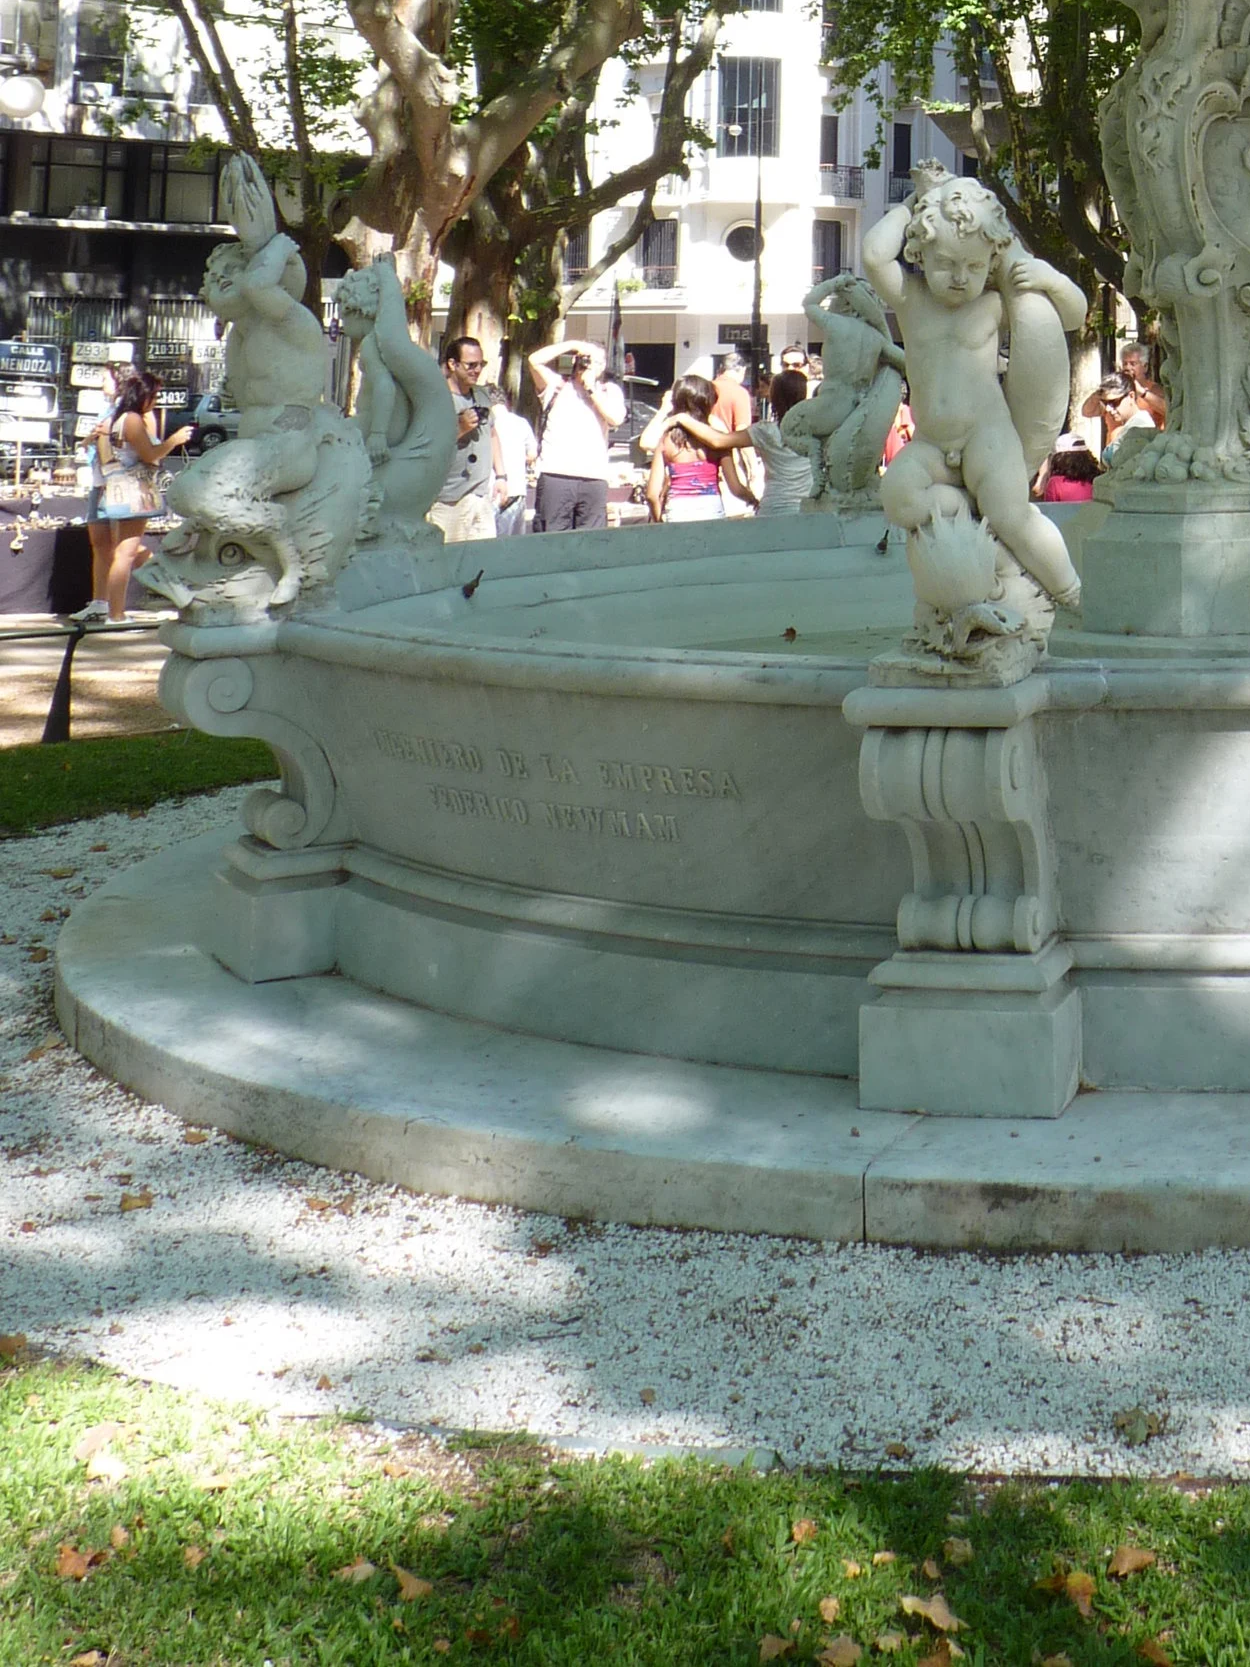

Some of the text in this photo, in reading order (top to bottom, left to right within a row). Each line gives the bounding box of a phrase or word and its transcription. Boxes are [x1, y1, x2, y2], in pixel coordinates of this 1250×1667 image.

[10, 345, 45, 356] CALLE
[0, 357, 52, 373] MENDOZA
[497, 748, 530, 780] DE
[540, 752, 581, 786] LA
[597, 759, 744, 802] EMPRESA
